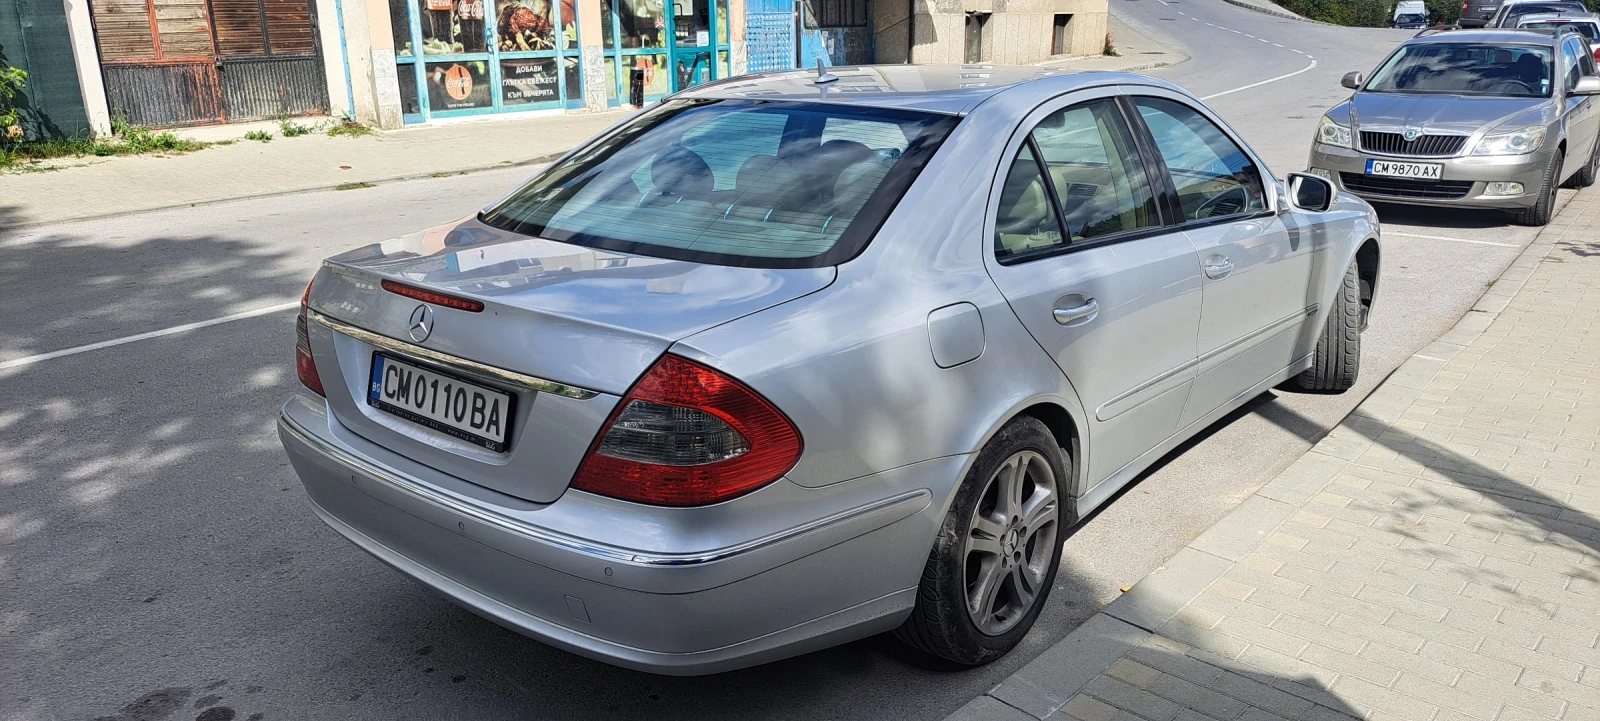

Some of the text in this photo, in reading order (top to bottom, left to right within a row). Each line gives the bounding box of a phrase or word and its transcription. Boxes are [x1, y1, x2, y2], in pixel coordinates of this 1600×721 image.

[516, 65, 543, 74] ДОБАВИ
[502, 76, 557, 87] ГЛЪТКА СВЕЖЕСТ
[507, 89, 554, 99] КЪМ ВЕЧЕРЯТА
[1374, 162, 1390, 174] CM
[1391, 163, 1420, 176] 9870
[1421, 165, 1439, 177] AX
[372, 381, 381, 393] BG
